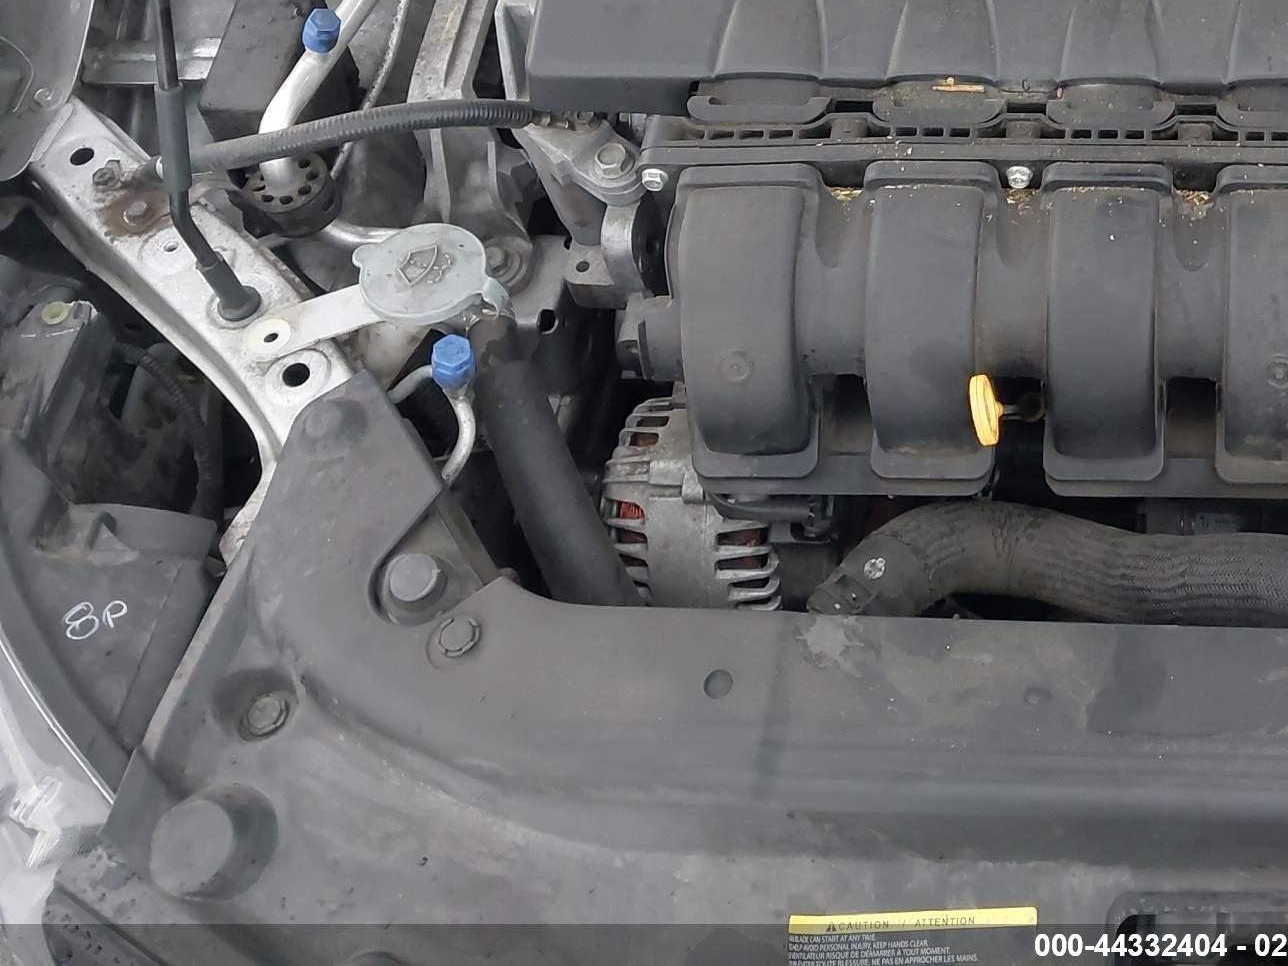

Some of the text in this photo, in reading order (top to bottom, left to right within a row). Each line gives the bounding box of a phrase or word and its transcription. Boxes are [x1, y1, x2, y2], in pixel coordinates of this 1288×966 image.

[838, 920, 889, 931] CAUTION
[915, 916, 975, 927] ATTENTION
[821, 935, 839, 943] START
[849, 934, 861, 942] ANY
[820, 943, 849, 952] PERSONAL
